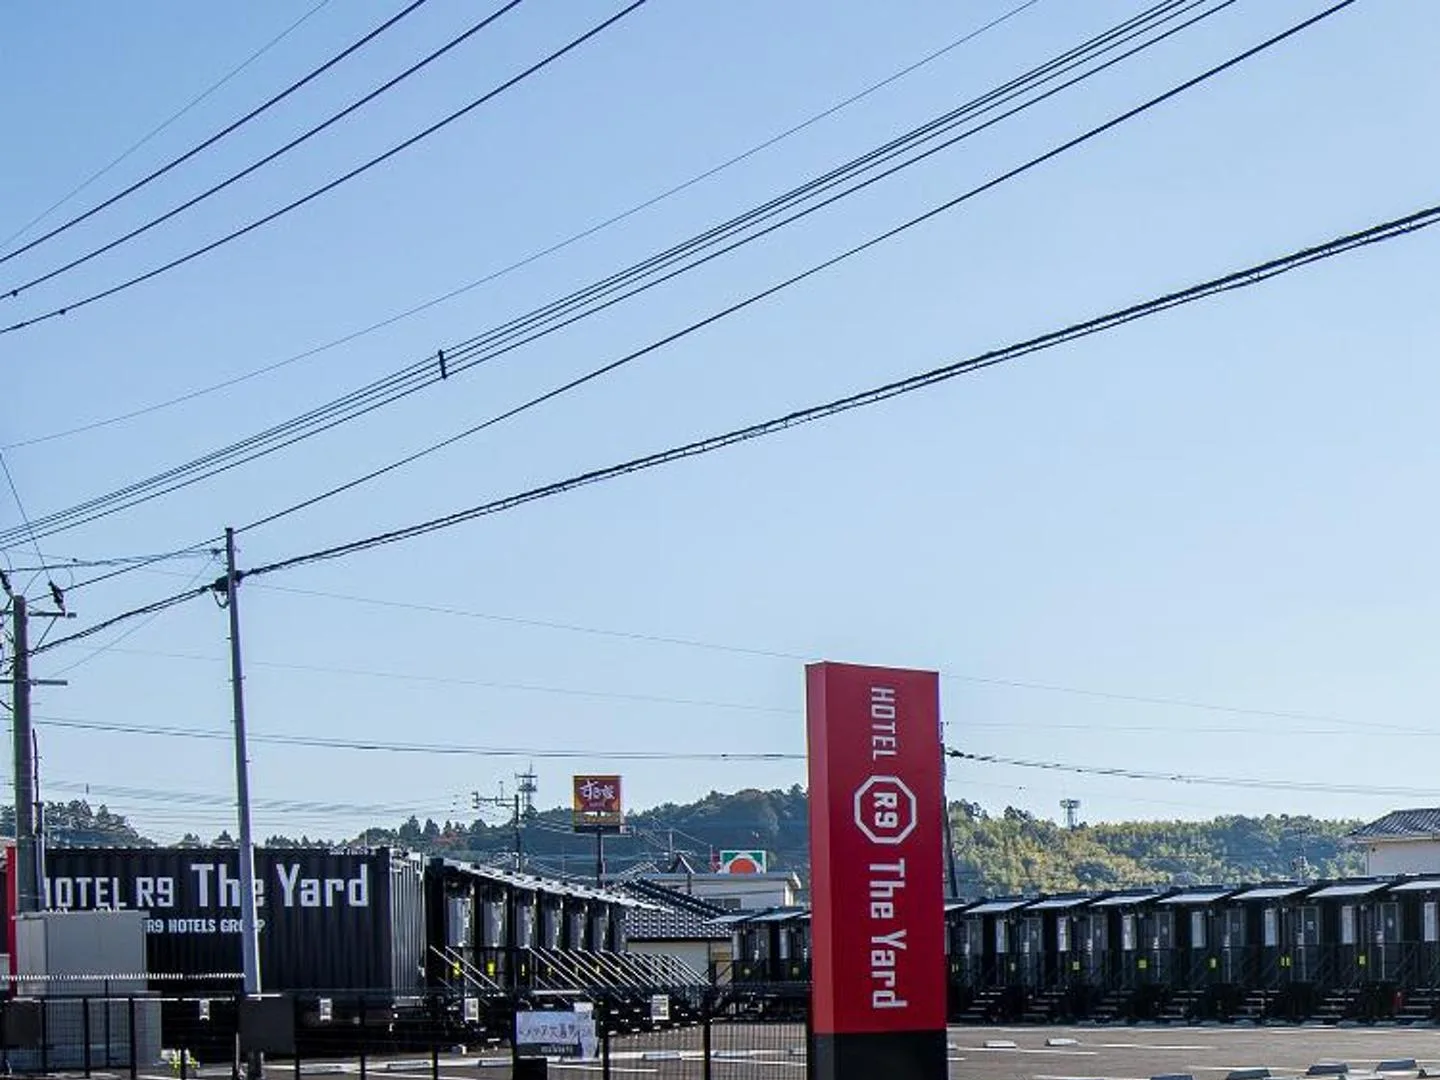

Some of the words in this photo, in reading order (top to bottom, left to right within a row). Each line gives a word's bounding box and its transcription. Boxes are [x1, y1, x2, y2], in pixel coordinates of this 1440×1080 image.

[871, 687, 897, 761] HOTEL
[873, 792, 898, 828] R9
[136, 877, 174, 907] R9
[276, 863, 368, 907] Yard
[869, 858, 905, 918] The
[147, 919, 164, 933] R9
[168, 919, 216, 933] HOTELS
[220, 919, 266, 932] GRP
[871, 929, 907, 1008] Yard
